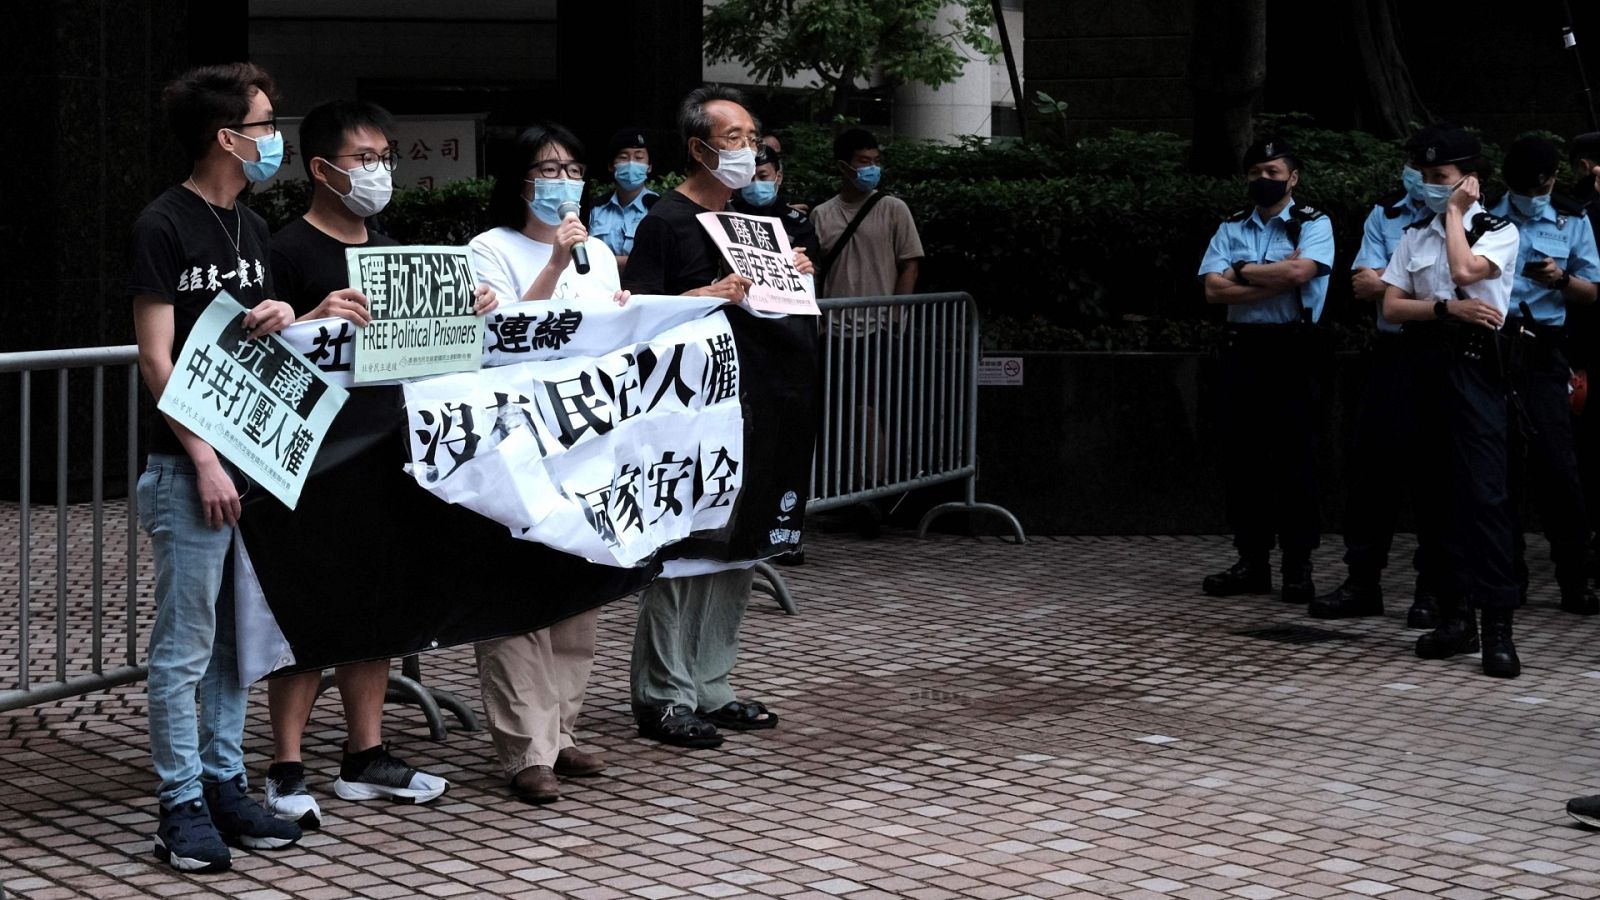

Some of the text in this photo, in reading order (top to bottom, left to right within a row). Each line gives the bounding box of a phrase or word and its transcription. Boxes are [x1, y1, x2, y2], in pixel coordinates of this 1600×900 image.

[728, 217, 774, 251] 廢除
[361, 254, 476, 318] 釋放政治犯
[726, 247, 807, 293] 國安惡法
[362, 319, 477, 350] FREE Political Prisoners
[231, 334, 314, 411] 抗議
[185, 343, 315, 478] 中共打壓人權
